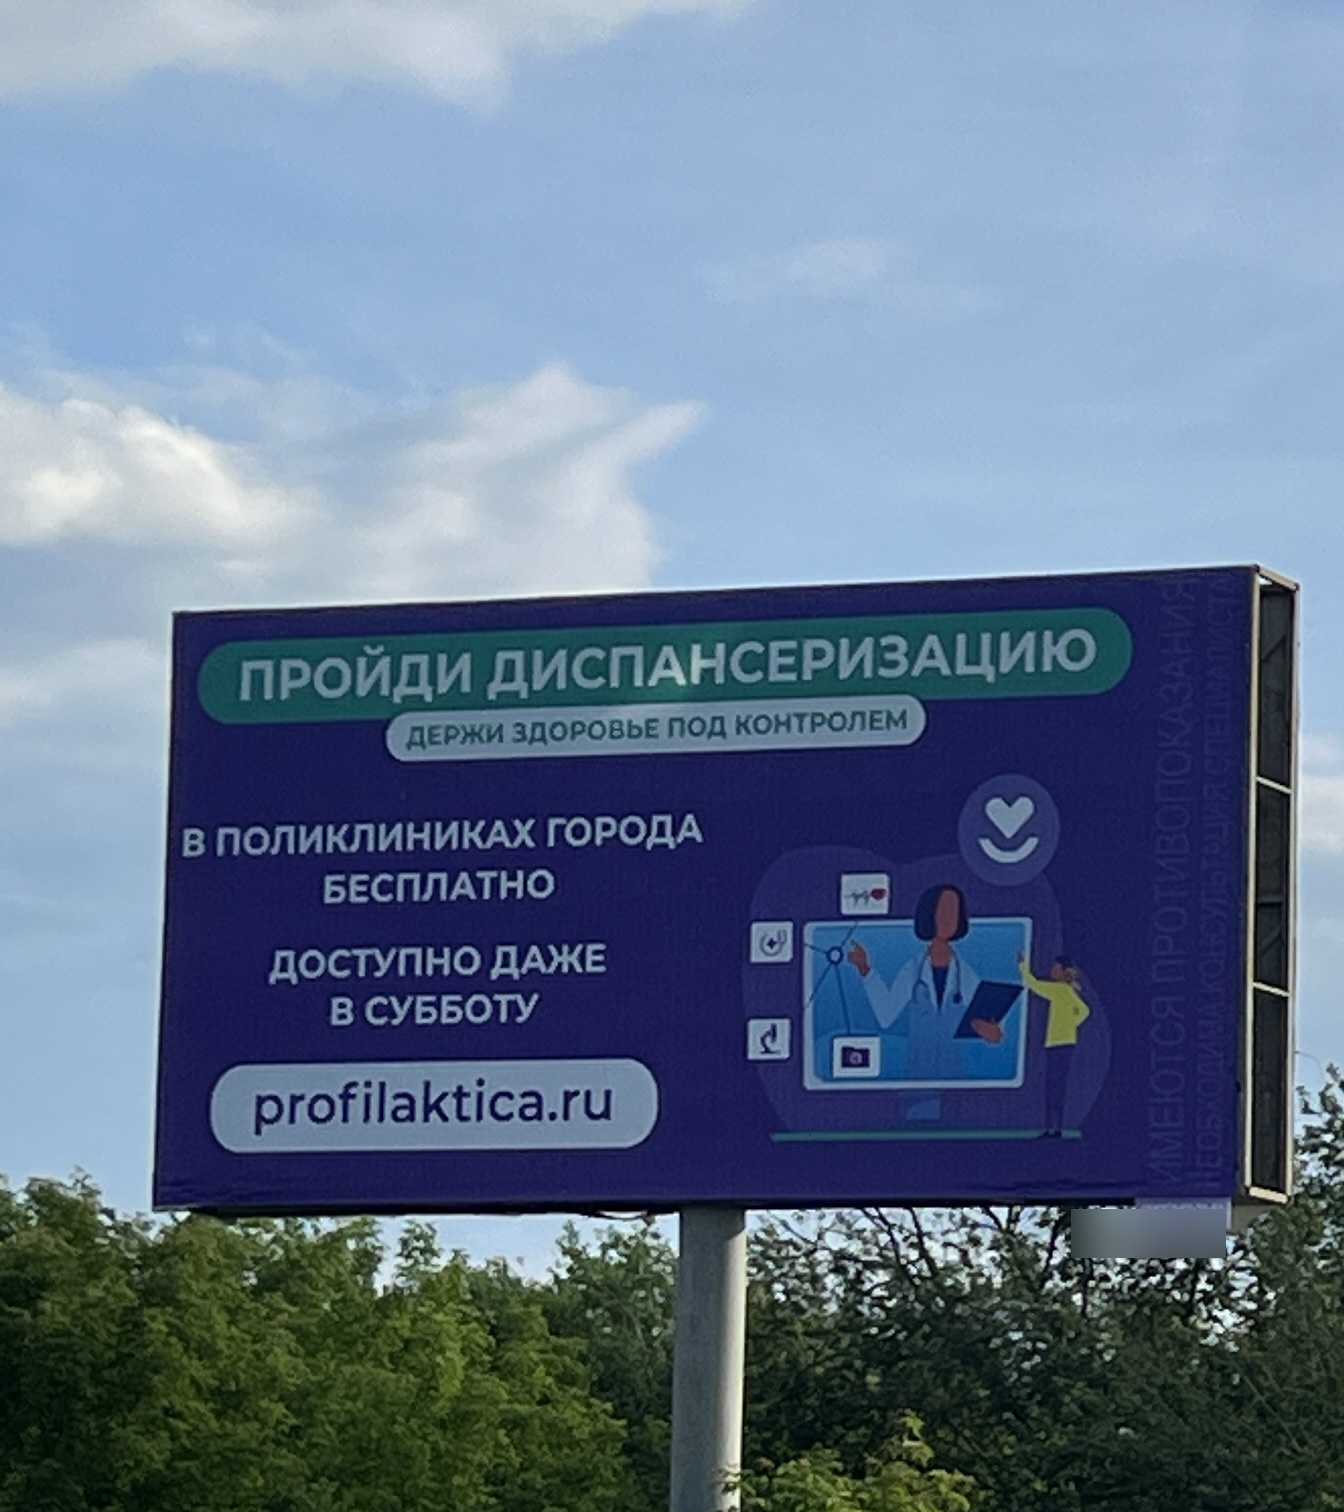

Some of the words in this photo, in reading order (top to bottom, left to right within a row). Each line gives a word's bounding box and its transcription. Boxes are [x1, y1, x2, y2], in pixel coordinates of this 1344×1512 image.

[239, 645, 473, 703] ПРОЙДИ
[487, 628, 1097, 700] ДИСПАНСЕРИЗАЦИЮ
[406, 722, 505, 751] ДЕРЖИ
[511, 717, 661, 747] ЗДОРОВЬЕ
[667, 715, 727, 743] ПОД
[735, 708, 909, 739] КОНТРОЛЕМ
[1150, 576, 1200, 984] ПРОТИВОПОКАЗАНИЯ
[182, 830, 206, 857] В
[217, 819, 537, 857] ПОЛИКЛИНИКАХ
[546, 813, 704, 849] ГОРОДА
[323, 868, 556, 905] БЕСПЛАТНО
[268, 945, 483, 986] ДОСТУПНО
[490, 943, 608, 981] ДАЖЕ
[330, 997, 355, 1028] В
[364, 993, 539, 1027] СУББОТУ
[253, 1078, 614, 1137] profilaktica.ru
[1149, 994, 1187, 1184] ИМЕЮТСЯ
